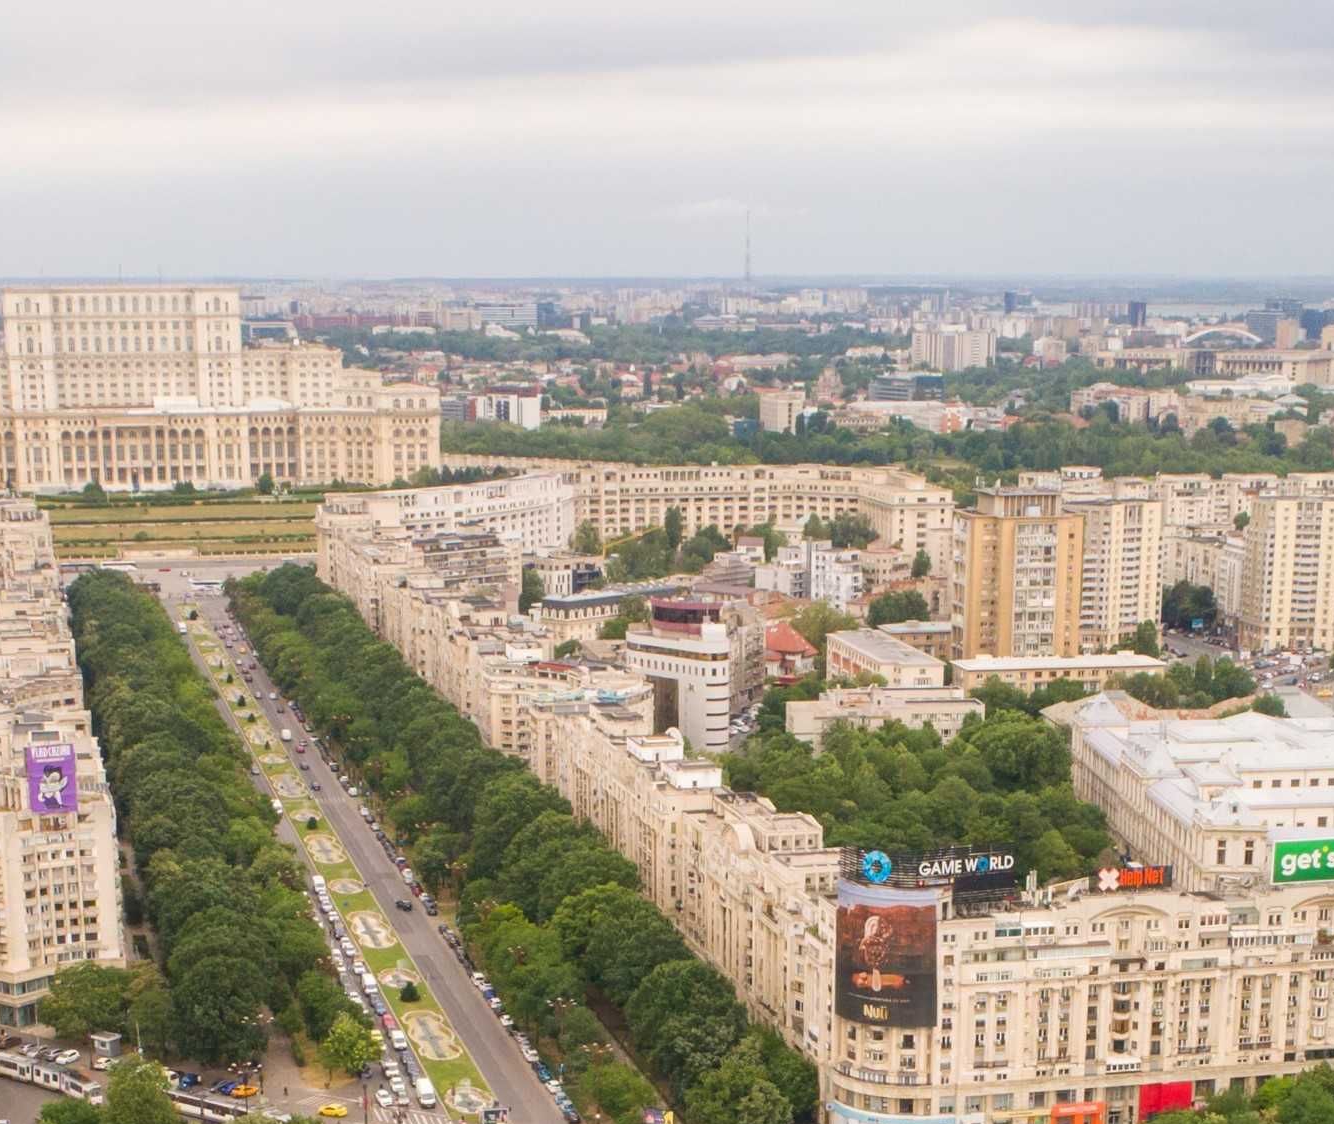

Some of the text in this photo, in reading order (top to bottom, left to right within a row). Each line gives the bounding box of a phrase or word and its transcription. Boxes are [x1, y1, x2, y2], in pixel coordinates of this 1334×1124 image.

[918, 855, 1014, 876] GAME WORLD
[1120, 866, 1164, 887] Help Net
